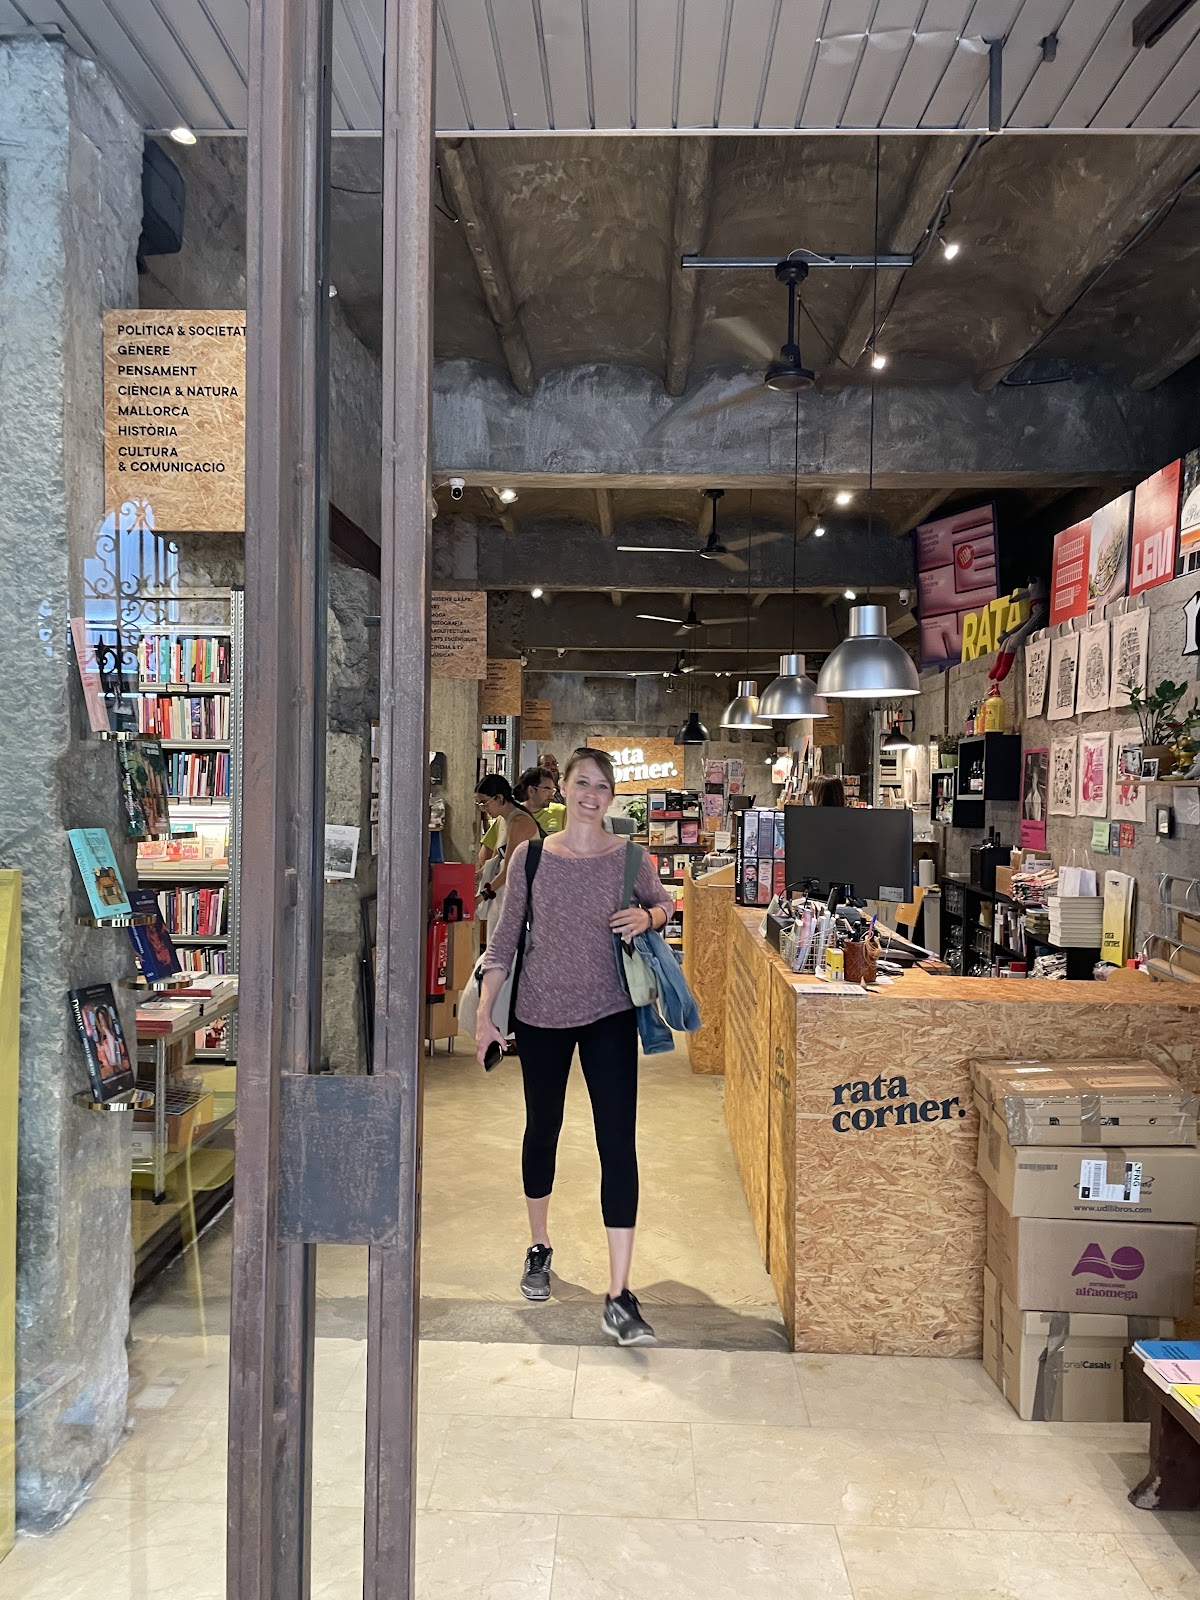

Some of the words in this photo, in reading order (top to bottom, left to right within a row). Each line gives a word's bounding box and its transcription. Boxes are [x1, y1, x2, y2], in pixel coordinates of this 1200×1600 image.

[117, 322, 174, 336] POLÍTICA
[177, 326, 186, 336] &
[189, 326, 247, 337] SOCIETAT
[117, 342, 171, 356] GÈNERE
[117, 366, 198, 376] PENSAMENT
[117, 383, 171, 396] CIÈNCIA
[175, 386, 184, 396] &
[187, 386, 239, 397] NATURA
[117, 406, 190, 416] MALLORCA
[117, 422, 178, 437] HISTÒRIA
[118, 446, 178, 457] CULTURA
[118, 462, 127, 472] &
[130, 459, 226, 473] COMUNICACIÓ
[961, 588, 1022, 664] RATA
[608, 747, 645, 766] ata
[613, 761, 678, 783] orner.
[832, 1074, 909, 1106] rata
[832, 1096, 966, 1133] corner.
[1075, 1287, 1138, 1301] alfaomega
